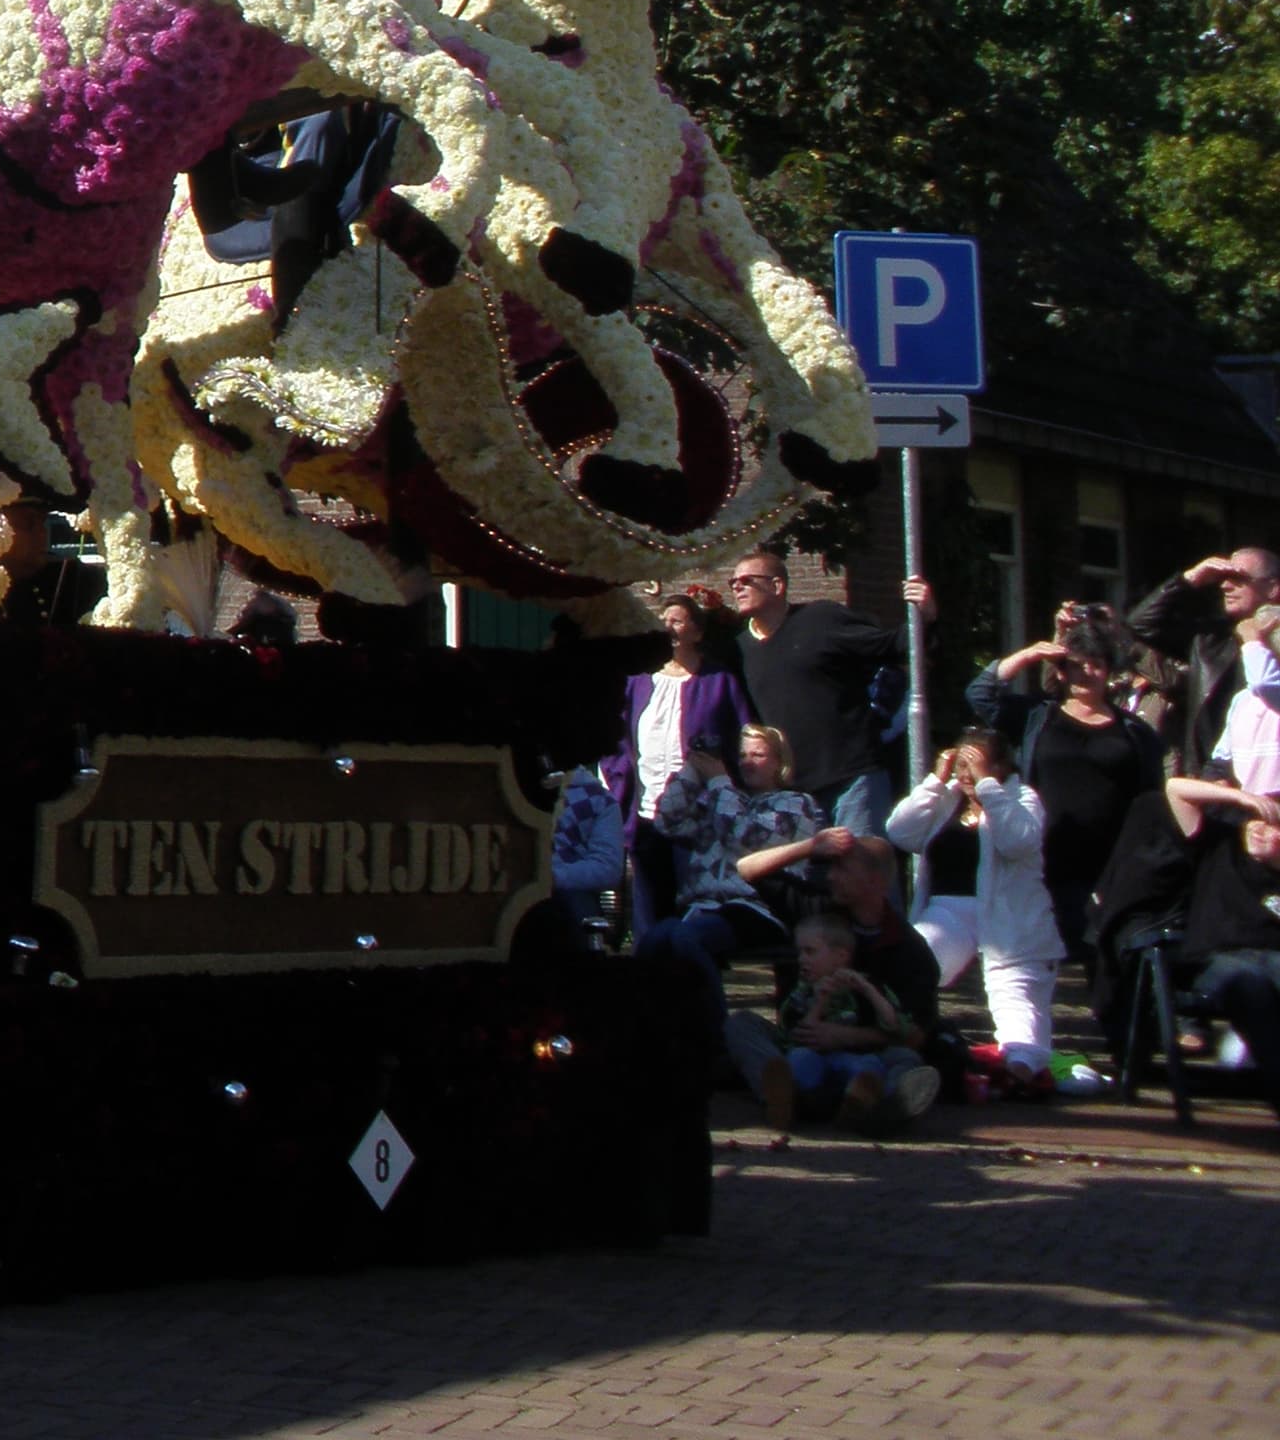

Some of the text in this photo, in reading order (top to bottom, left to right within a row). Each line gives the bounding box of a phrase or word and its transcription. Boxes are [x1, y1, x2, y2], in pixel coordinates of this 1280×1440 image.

[875, 257, 946, 367] P
[81, 818, 509, 897] TEN STRIJDE
[375, 1139, 390, 1183] 8
